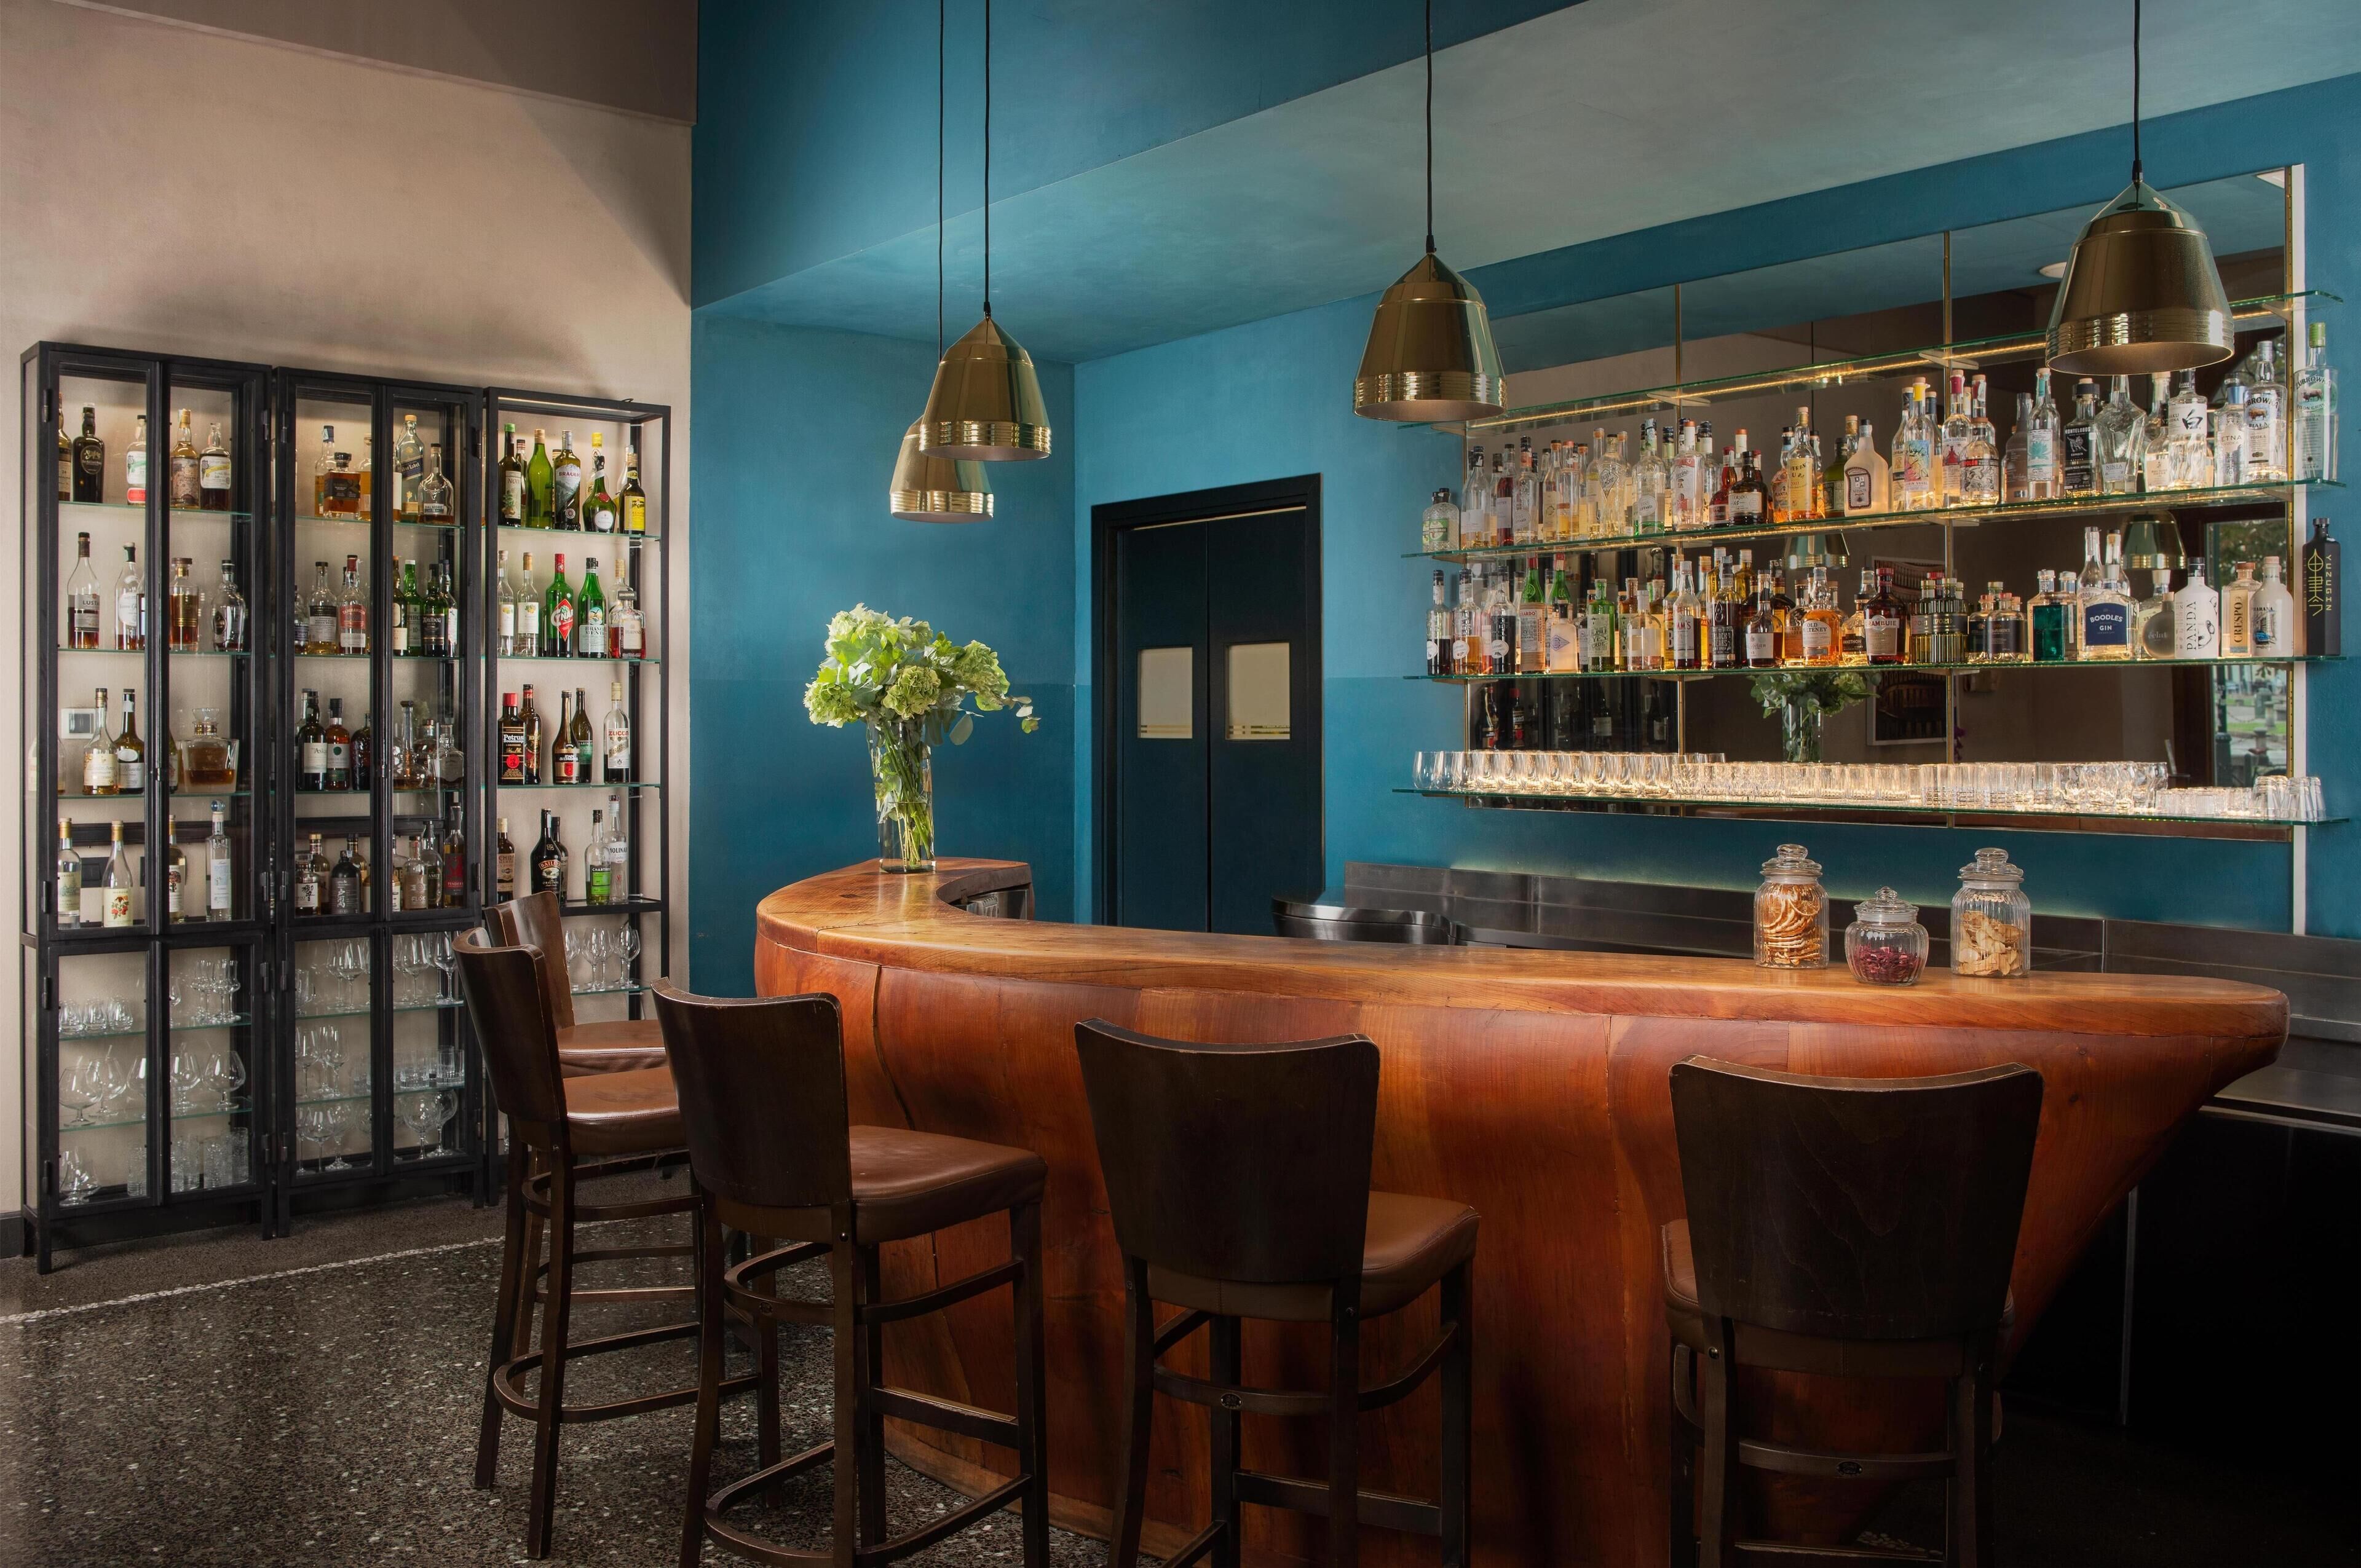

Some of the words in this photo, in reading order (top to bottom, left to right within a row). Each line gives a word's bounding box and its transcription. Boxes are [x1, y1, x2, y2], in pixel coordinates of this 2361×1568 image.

[2089, 614, 2124, 623] BOODLES
[2186, 601, 2197, 652] PANDA
[2234, 601, 2244, 644] CRESPO
